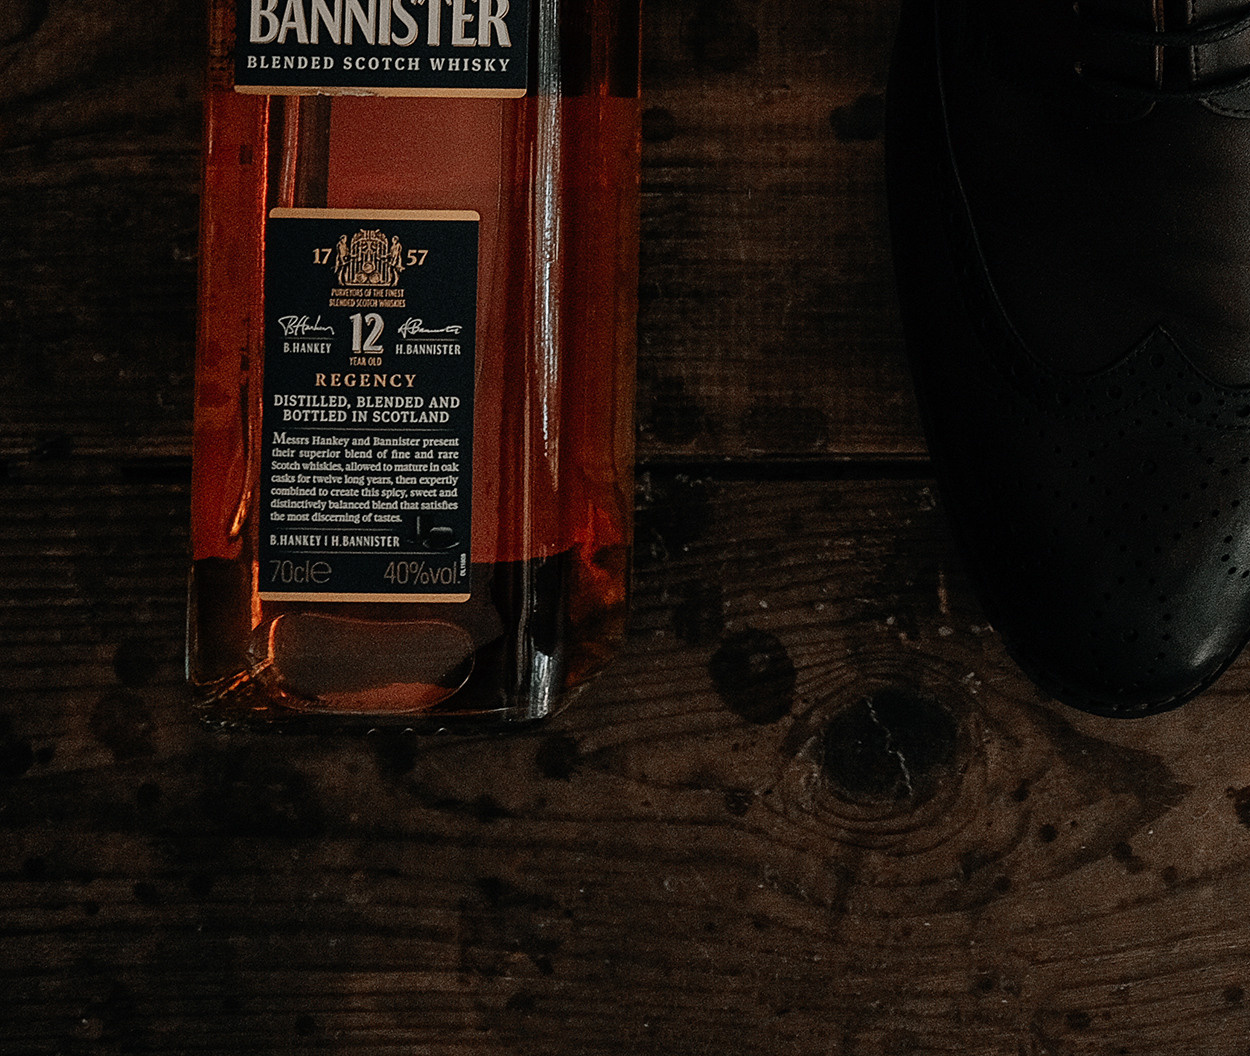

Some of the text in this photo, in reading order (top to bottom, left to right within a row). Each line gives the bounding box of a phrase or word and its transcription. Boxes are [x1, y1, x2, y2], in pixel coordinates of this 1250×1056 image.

[247, 56, 511, 73] BLENDED SCOTCH WHISKY
[312, 248, 333, 265] 17
[406, 249, 429, 267] 57
[373, 289, 384, 297] THE
[329, 299, 355, 307] BLENDED
[356, 299, 378, 307] SCOTCH
[349, 313, 384, 354] 12
[283, 342, 332, 354] B.HANKEY
[396, 344, 461, 355] H.BANNISTER
[349, 357, 382, 366] YEAR OLD
[315, 372, 416, 388] REGENCY
[274, 394, 460, 409] DISTILLED, BLENDED AND
[283, 410, 450, 423] BOTTLED IN SCOTLAND
[272, 431, 459, 448] Messrs Hankey and Bannister present
[271, 447, 459, 460] their superior blend of fine and rare
[271, 461, 459, 472] Scotch whiskies, allowed to mature in oak
[271, 473, 459, 486] casks for twelve long years, then expertly
[270, 486, 458, 499] combined to create this spicy, sweet and
[270, 499, 459, 511] distinctively balanced blend that satisfies
[270, 511, 403, 524] the most discerning of tastes.
[269, 535, 322, 547] B.HANKEY
[331, 536, 400, 548] H.BANNISTER
